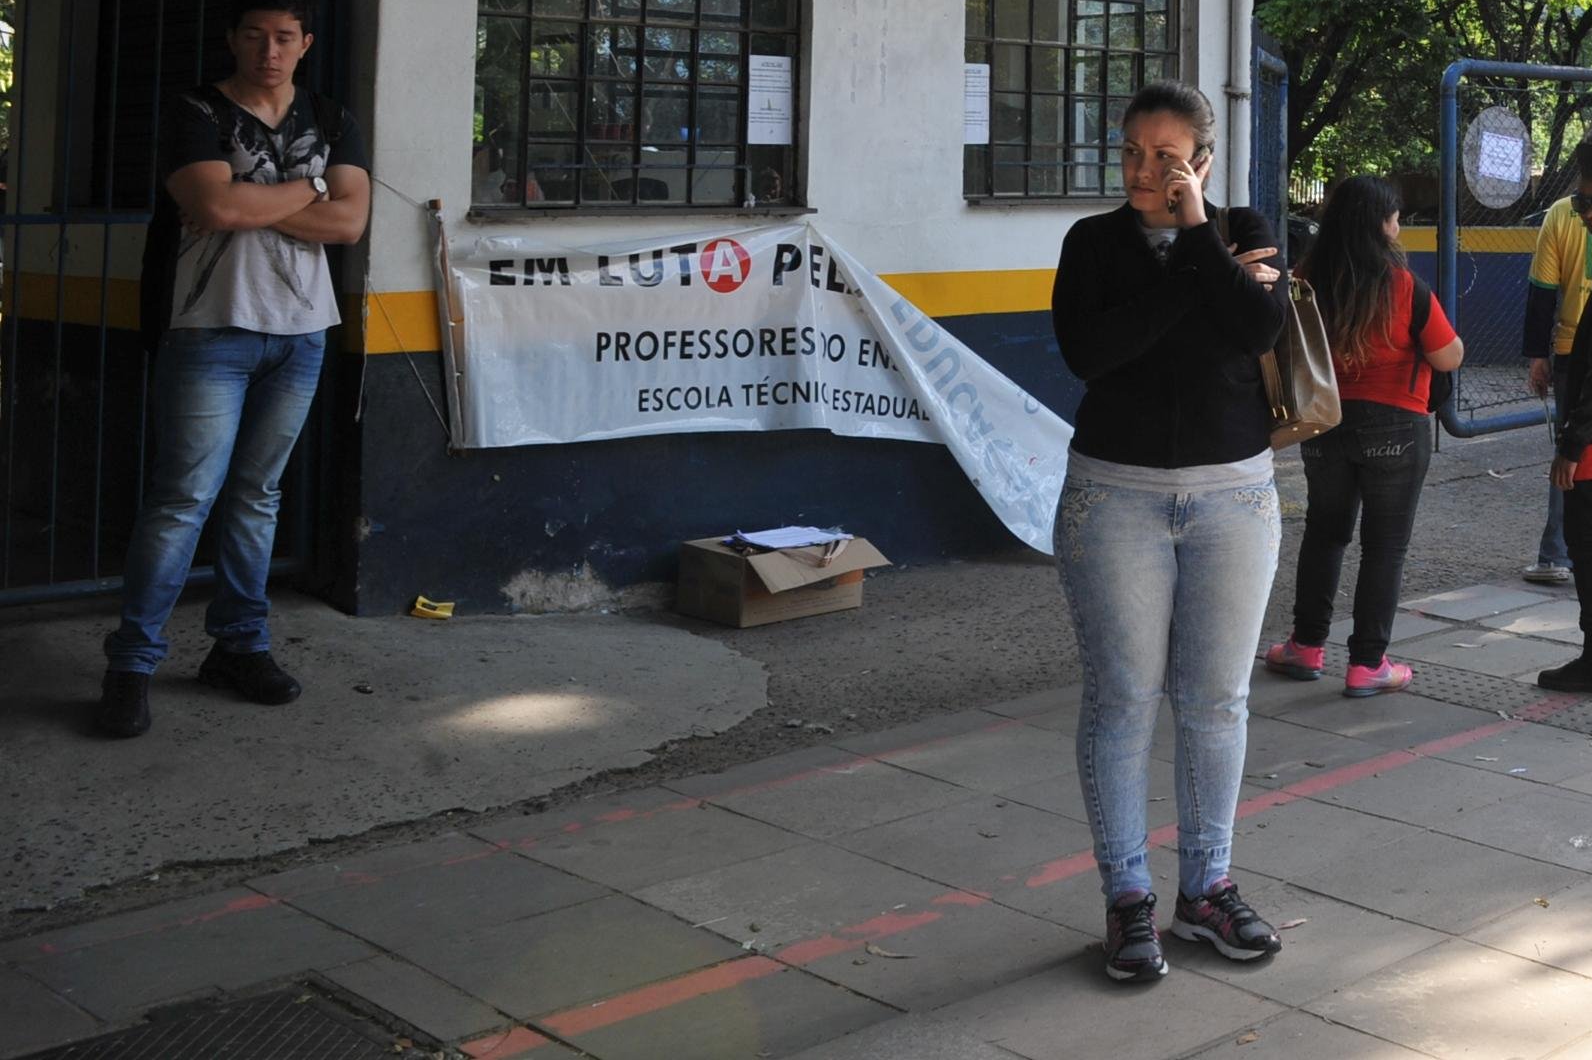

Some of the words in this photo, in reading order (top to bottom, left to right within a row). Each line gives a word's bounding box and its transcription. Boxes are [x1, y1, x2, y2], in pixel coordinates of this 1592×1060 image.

[488, 256, 572, 287] EM
[597, 241, 746, 288] LUTA
[594, 326, 817, 362] PROFESSORES
[820, 330, 846, 363] O
[637, 385, 733, 413] ESCOLA
